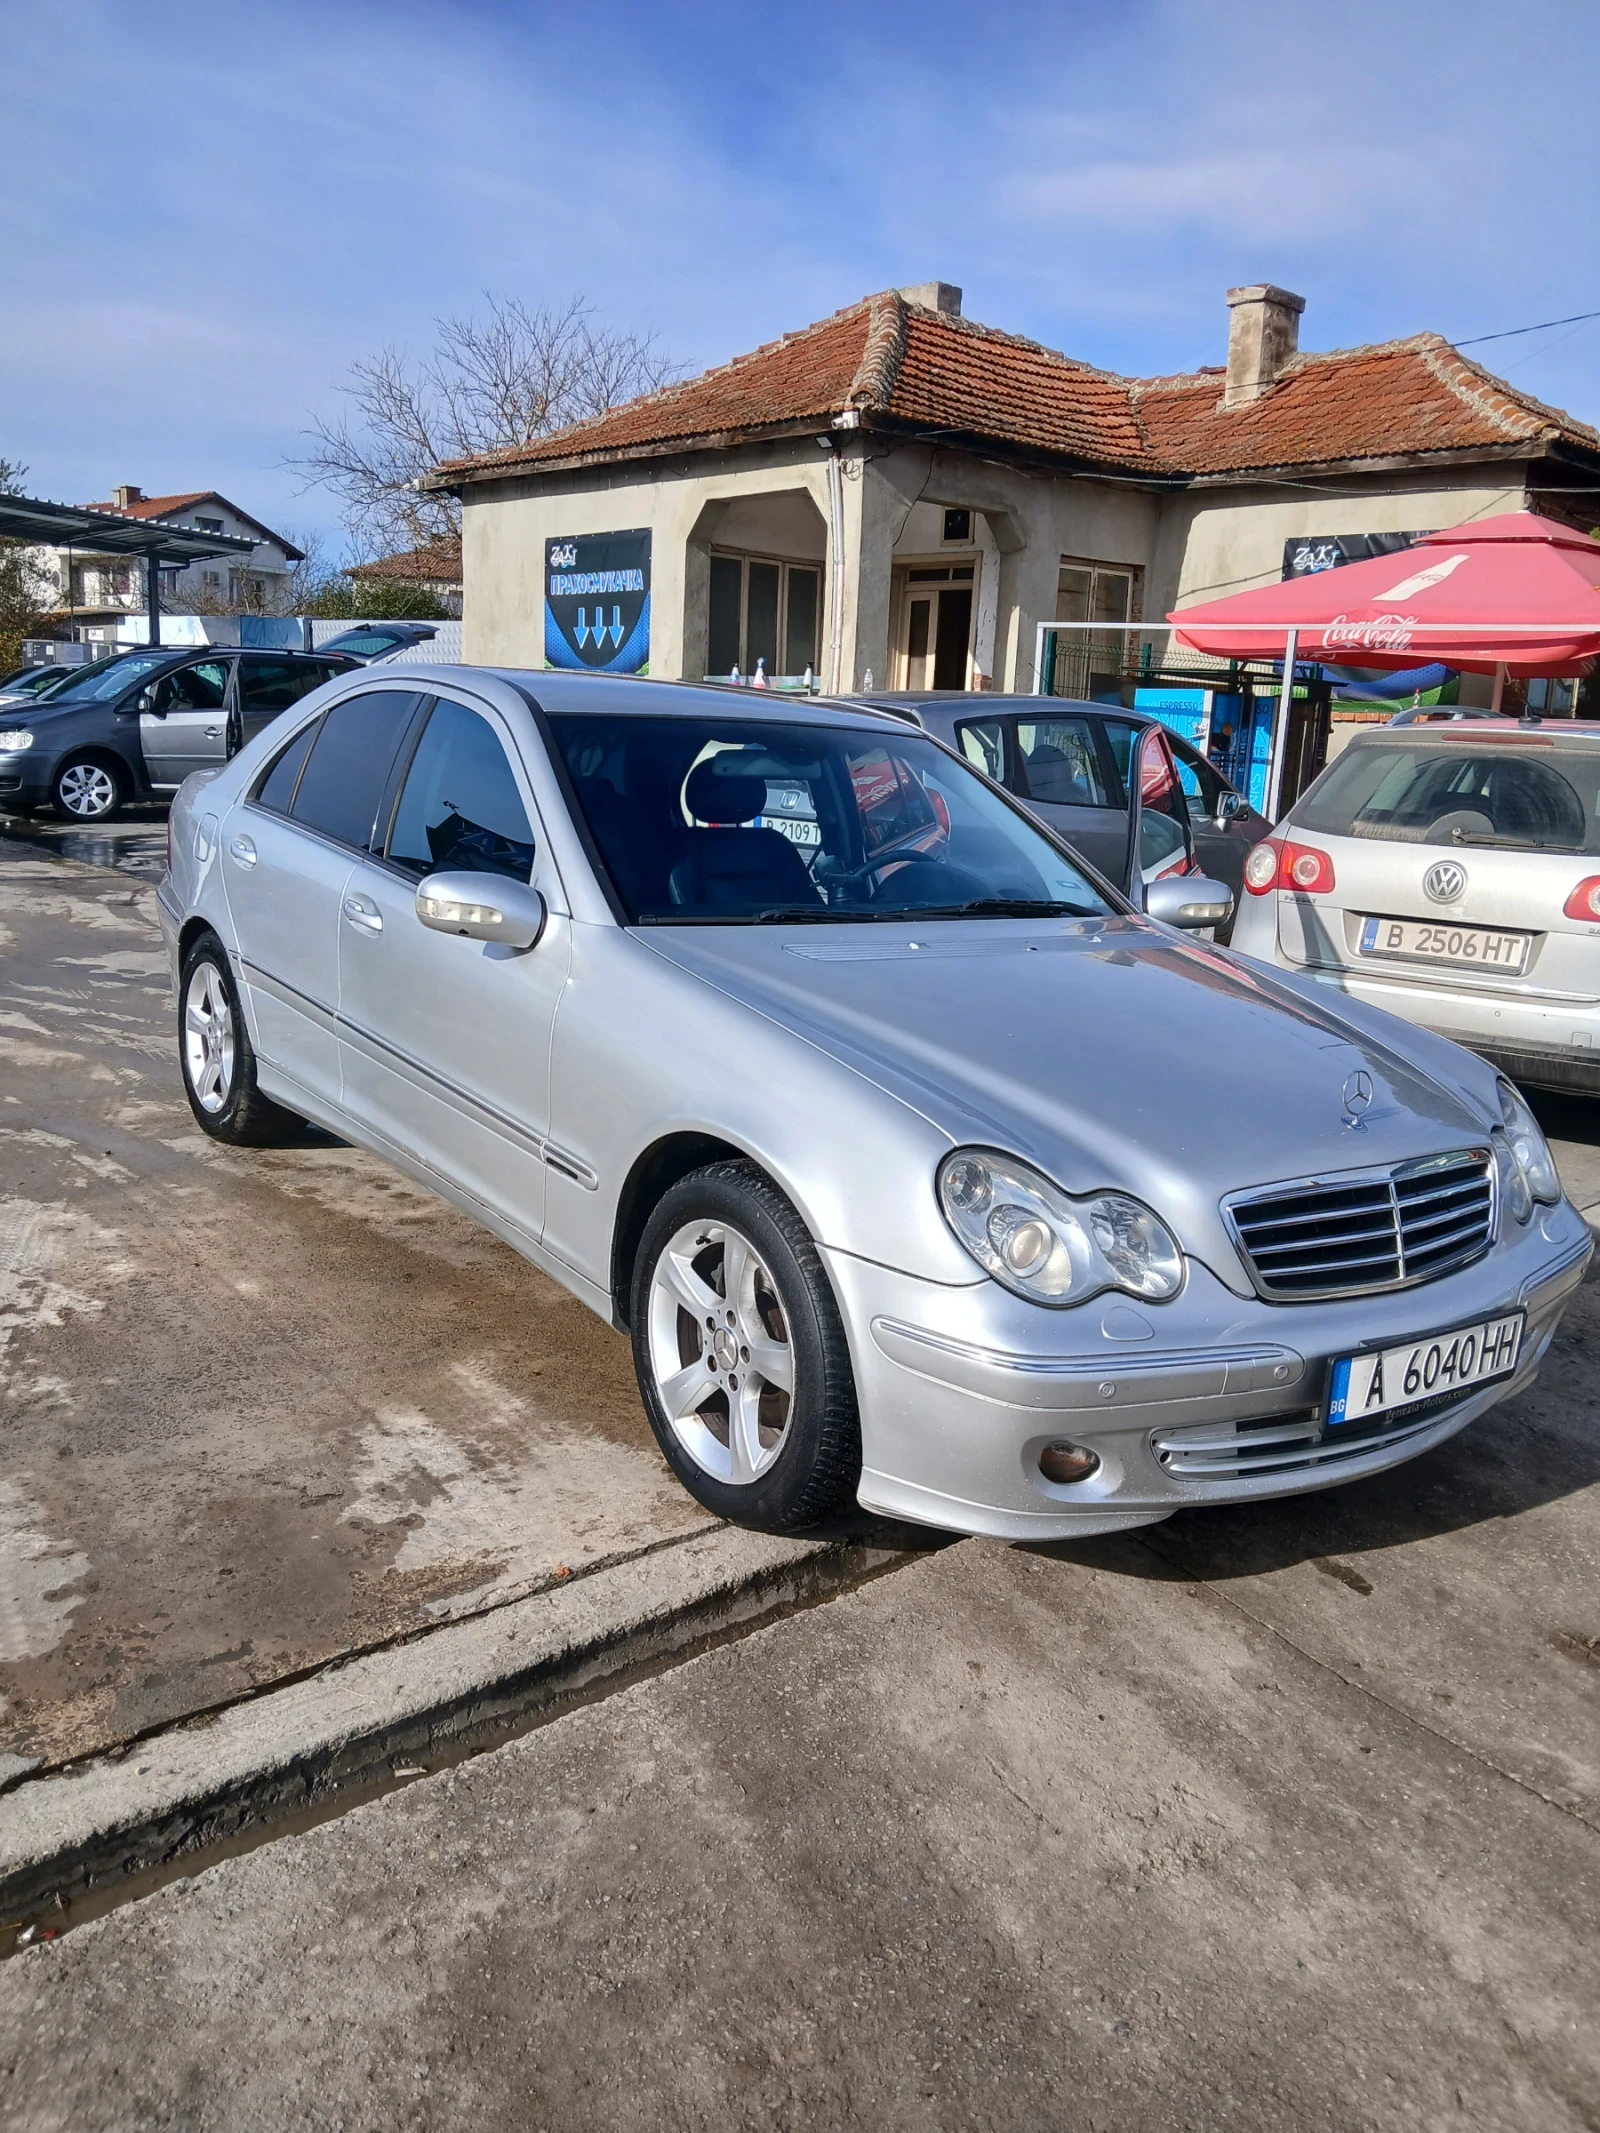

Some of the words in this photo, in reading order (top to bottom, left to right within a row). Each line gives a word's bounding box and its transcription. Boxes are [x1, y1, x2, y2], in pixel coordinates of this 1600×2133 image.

[550, 568, 644, 596] ПРАХОСМУКАЧКА
[1159, 700, 1199, 711] ESPRESSO
[1363, 936, 1375, 948] BG
[1387, 924, 1403, 949] B
[1415, 928, 1478, 959] 2506
[1483, 935, 1520, 964] HT
[1363, 1351, 1385, 1409] A
[1329, 1398, 1346, 1416] BG
[1385, 1387, 1471, 1421] Venezia-Motors.com
